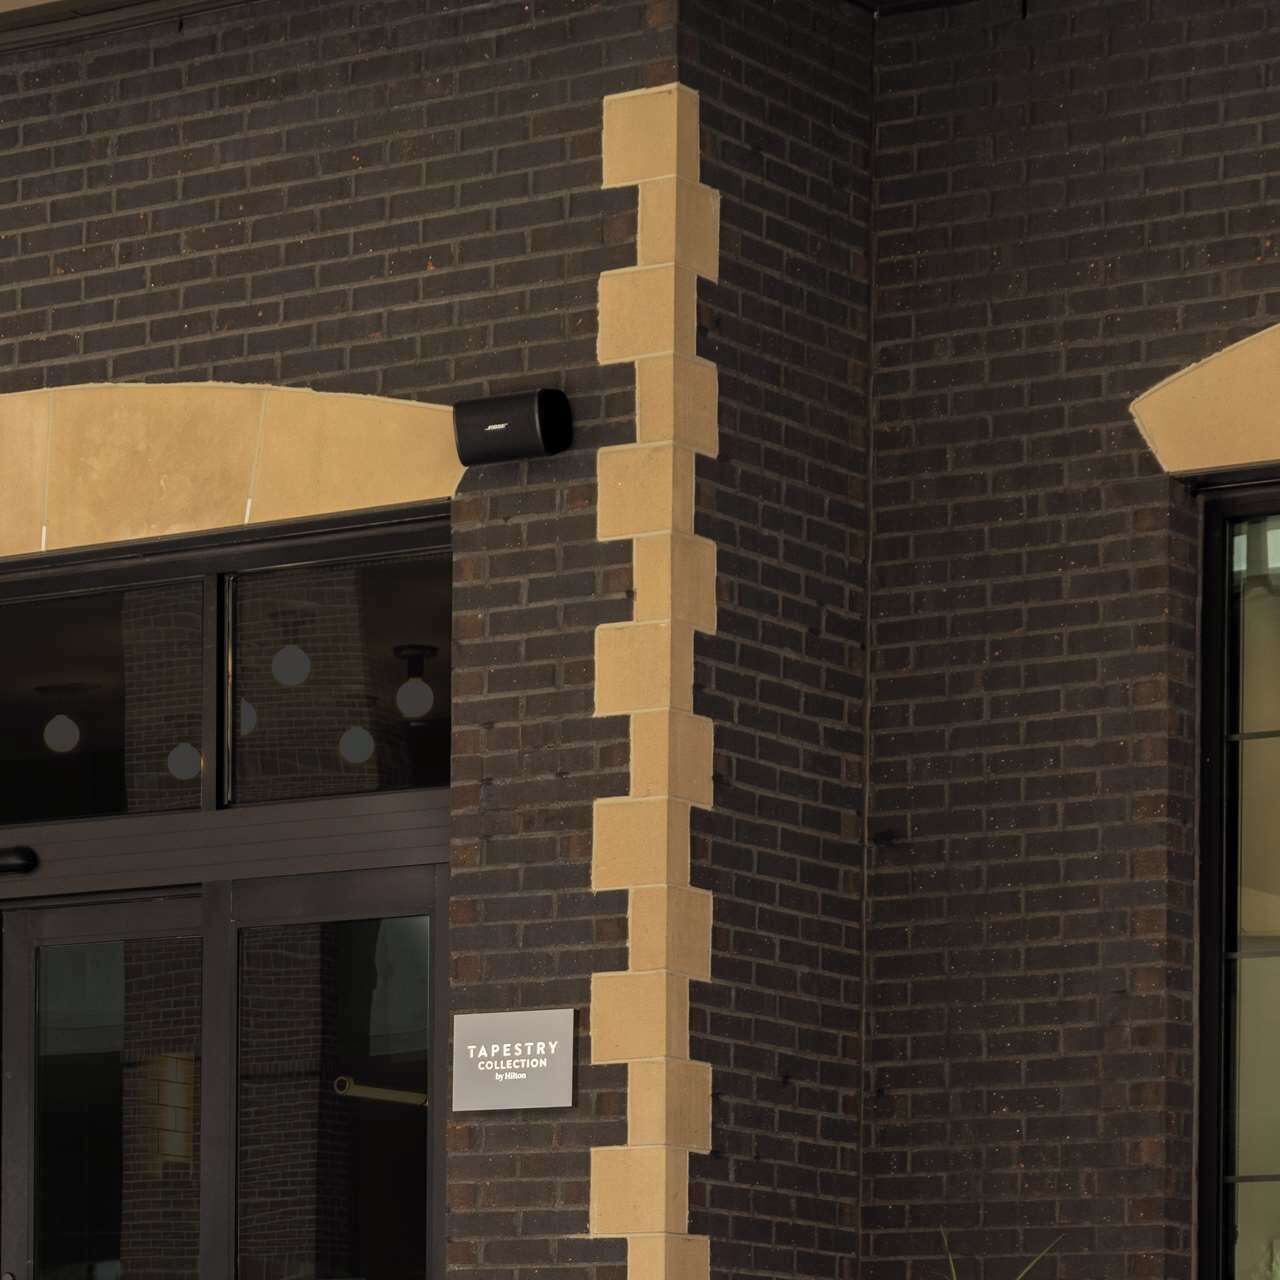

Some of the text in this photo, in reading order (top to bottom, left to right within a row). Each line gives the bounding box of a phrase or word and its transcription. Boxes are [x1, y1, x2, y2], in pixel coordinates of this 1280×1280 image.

[467, 1041, 558, 1059] TAPESTRY
[477, 1058, 548, 1071] COLLECTION
[495, 1071, 527, 1082] by Hilton
